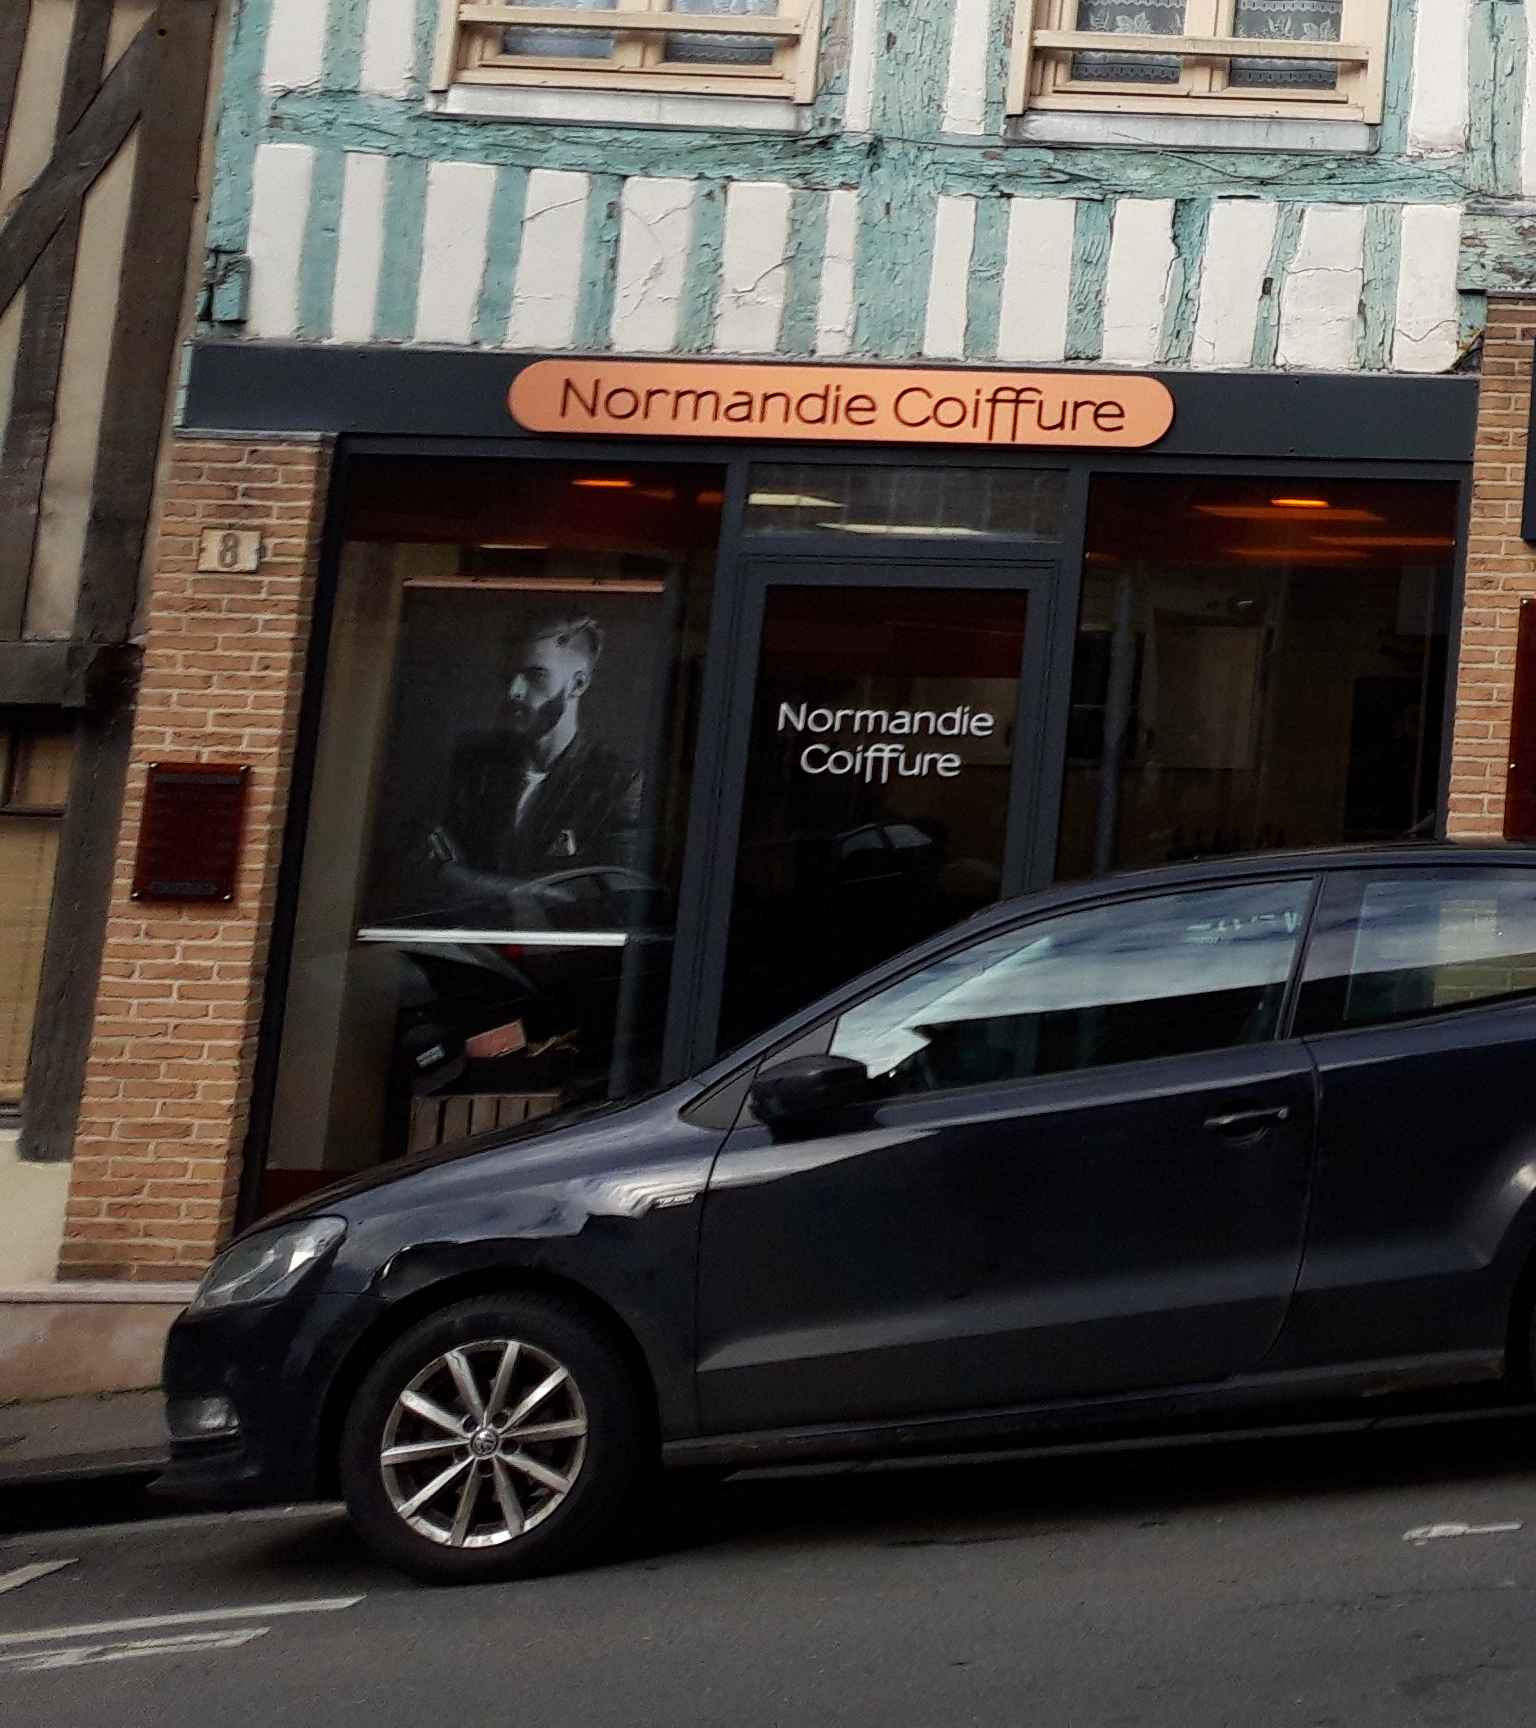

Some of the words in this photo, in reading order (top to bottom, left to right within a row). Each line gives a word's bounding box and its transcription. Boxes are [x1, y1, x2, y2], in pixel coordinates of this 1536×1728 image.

[559, 377, 878, 427] Normandie
[892, 385, 1126, 442] Coiffure
[217, 531, 240, 570] 8
[777, 701, 996, 737] Normandie
[800, 742, 963, 785] Coiffure
